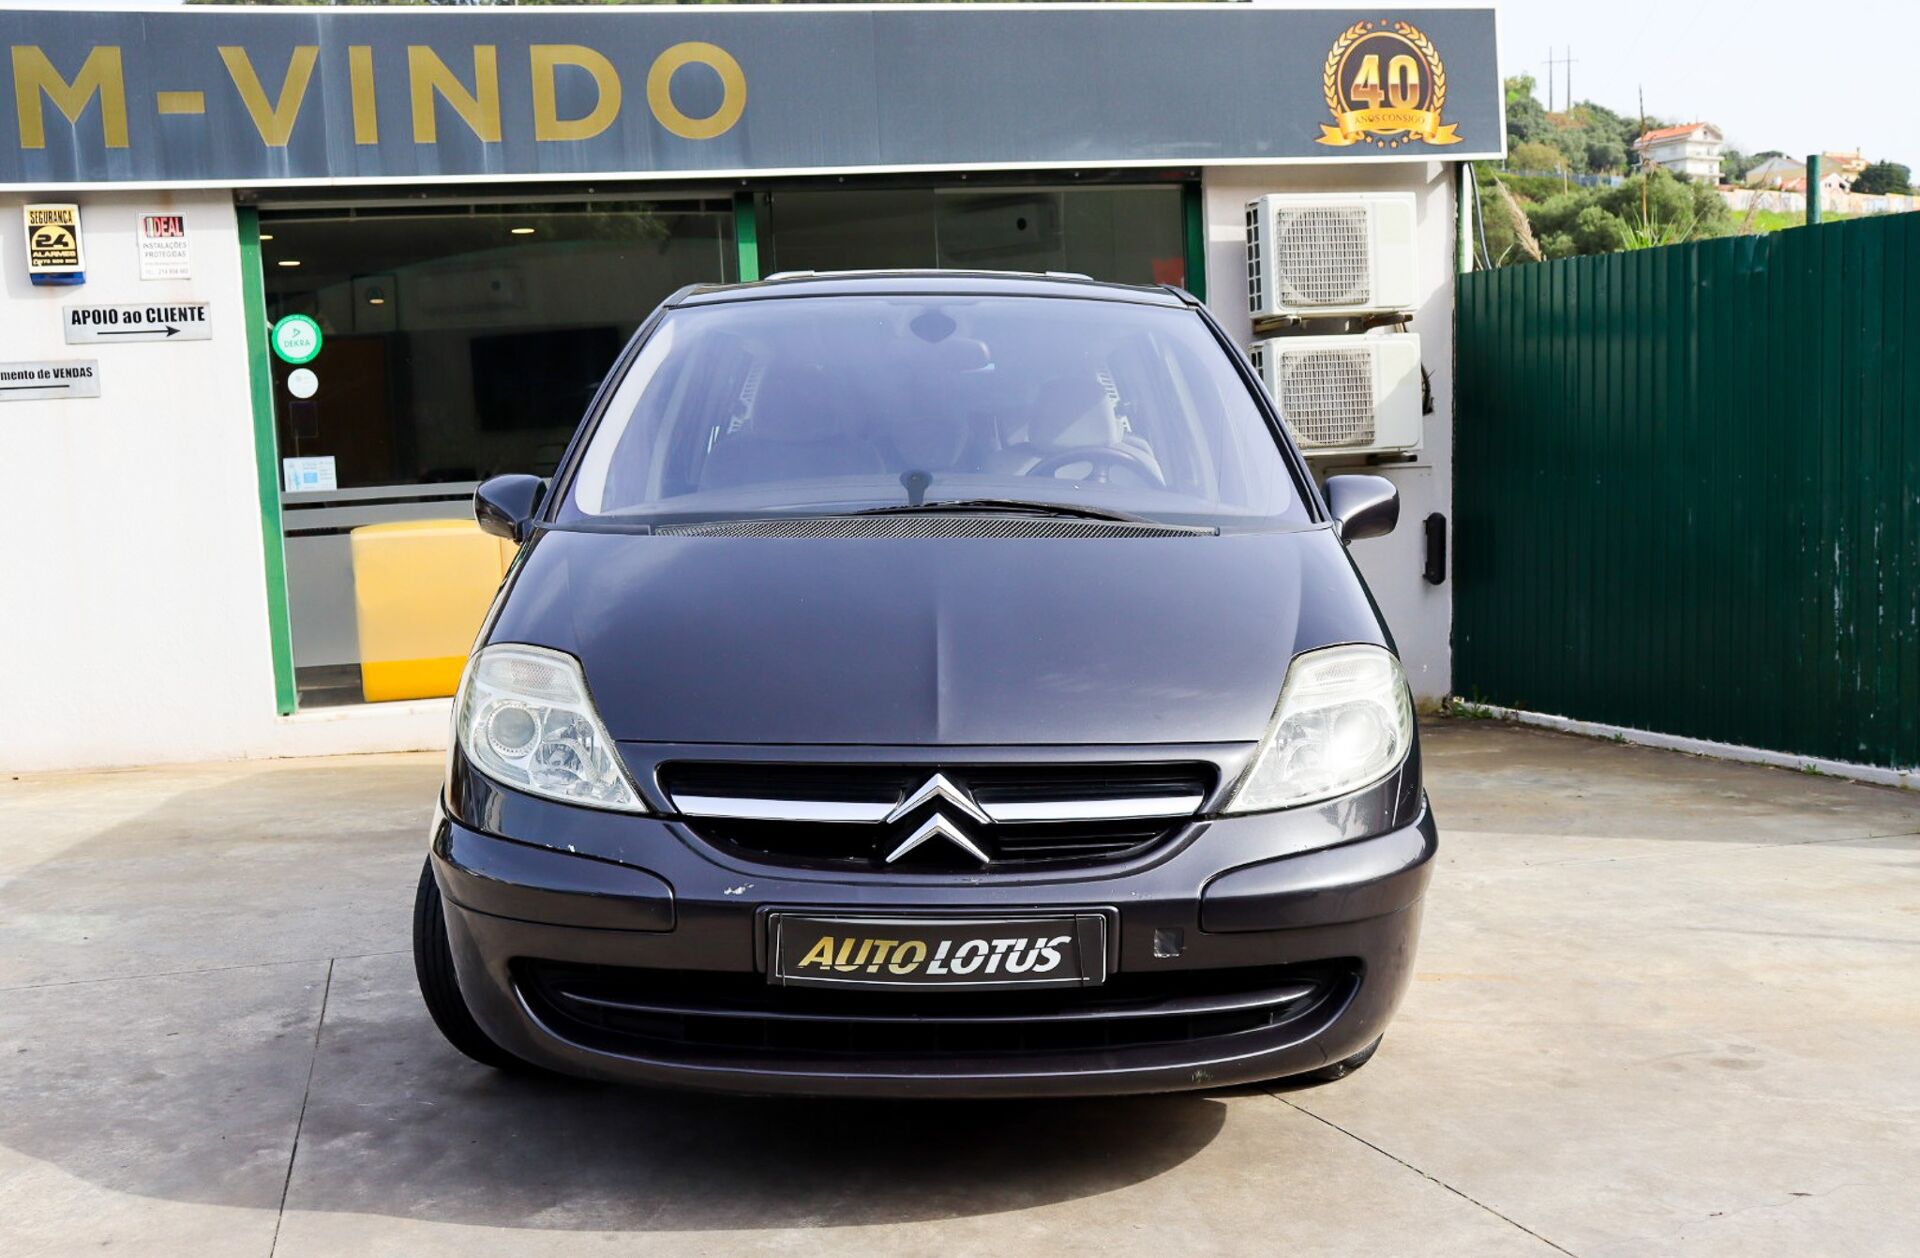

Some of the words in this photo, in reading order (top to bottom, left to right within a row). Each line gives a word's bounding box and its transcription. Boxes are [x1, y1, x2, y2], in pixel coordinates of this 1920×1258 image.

[1351, 54, 1420, 110] 40
[12, 42, 747, 148] M-VINDO
[1355, 114, 1380, 125] ANOS
[1382, 113, 1425, 124] CONSIGO
[36, 233, 69, 248] 24
[143, 241, 187, 250] INSTALAÇÕES
[144, 250, 187, 258] PROTEGIDAS
[71, 309, 118, 325] APOIO
[122, 311, 142, 324] ao
[146, 306, 206, 323] CLIENTE
[284, 339, 311, 348] DEKRA
[0, 370, 35, 380] mento
[37, 368, 51, 379] de
[52, 366, 93, 378] VENDAS
[798, 936, 927, 974] AUTO
[926, 935, 1072, 976] LOTUS
